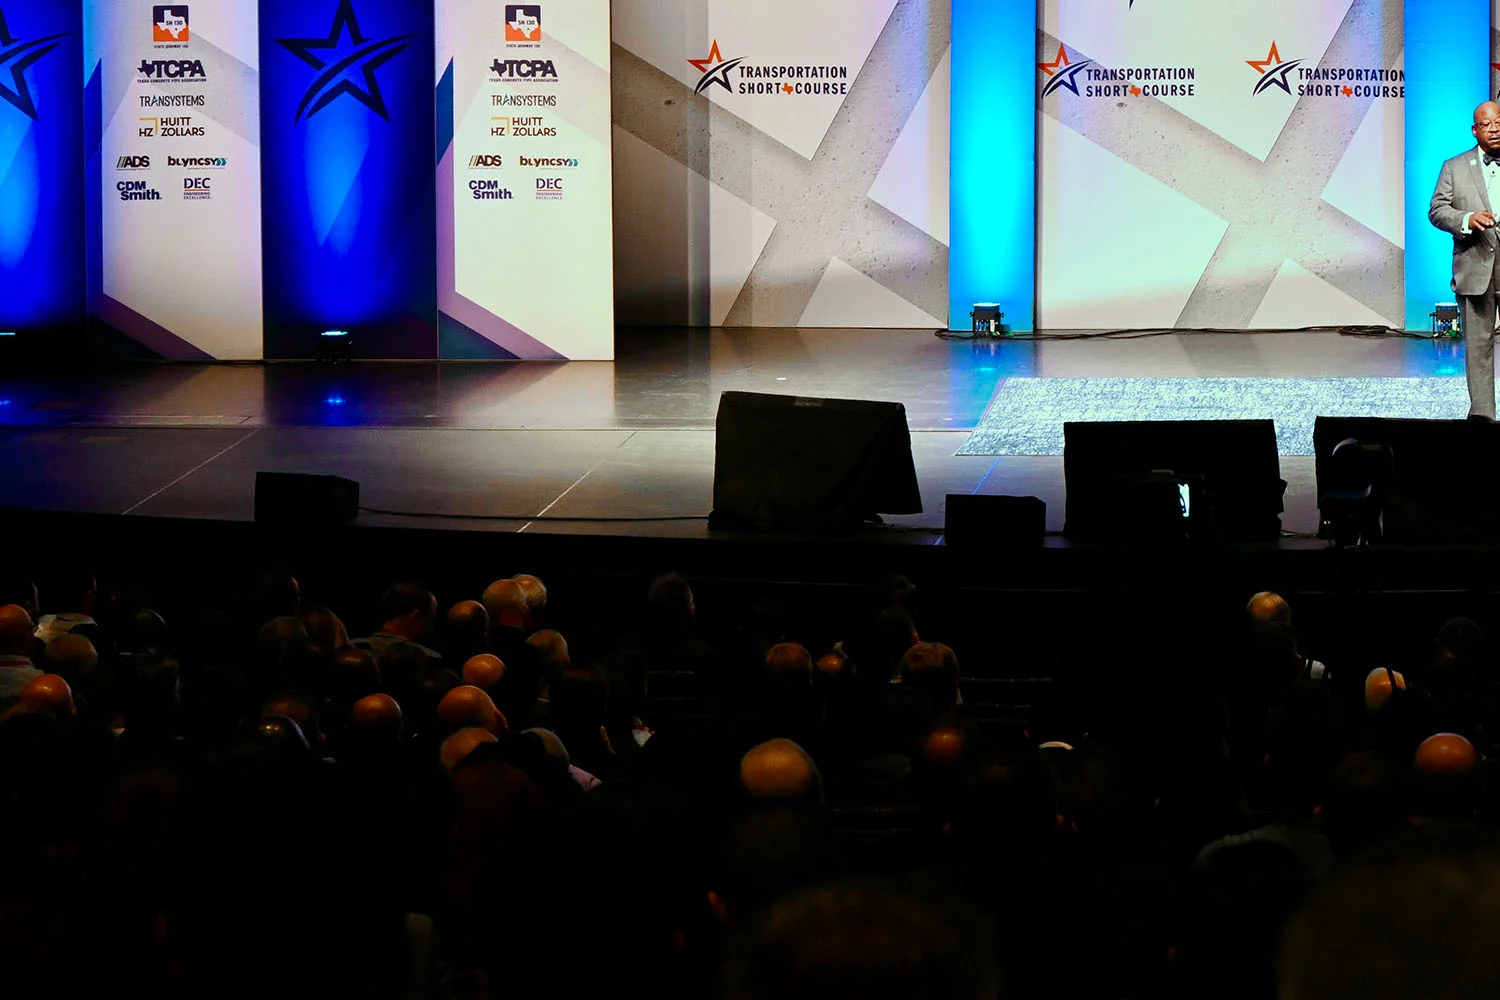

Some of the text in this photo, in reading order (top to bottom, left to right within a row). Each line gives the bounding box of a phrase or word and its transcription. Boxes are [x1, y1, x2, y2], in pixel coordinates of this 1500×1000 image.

[153, 60, 206, 78] TCPA
[506, 60, 558, 78] TCPA
[739, 66, 847, 79] TRANSPORTATION
[1086, 68, 1195, 81] TRANSPORTATION
[1298, 68, 1405, 82] TRANSPORTATION
[739, 82, 847, 94] SHORT COURSE
[1086, 84, 1194, 97] SHORT COURSE
[140, 94, 205, 107] TRANSYSTEMS
[491, 94, 557, 106] TRANSYSTEMS
[160, 117, 191, 126] HUITT
[512, 117, 543, 126] HUITT
[139, 128, 154, 137] HZ
[160, 127, 205, 137] ZOLLARS
[491, 127, 506, 137] HZ
[513, 127, 557, 137] ZOLLARS
[116, 181, 146, 191] CDM
[184, 178, 210, 189] DEC
[468, 180, 498, 190] CDM
[536, 178, 563, 189] DEC
[120, 188, 160, 201] Smith
[473, 188, 512, 200] Smith
